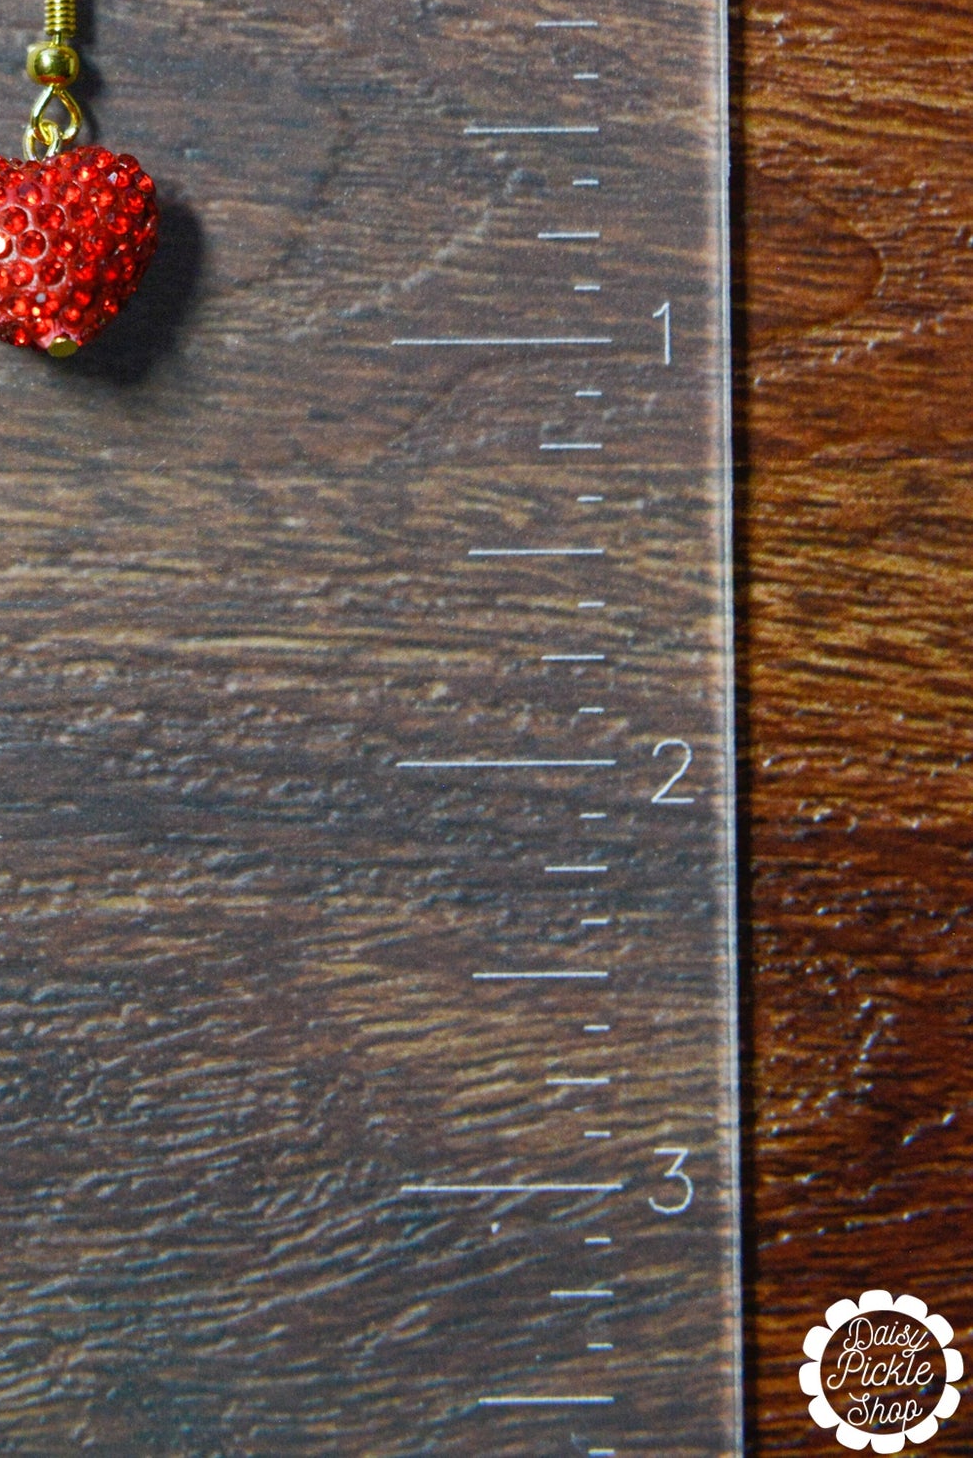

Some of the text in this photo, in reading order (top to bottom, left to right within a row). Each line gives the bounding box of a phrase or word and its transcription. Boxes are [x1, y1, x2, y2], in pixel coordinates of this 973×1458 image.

[652, 301, 671, 366] 1
[651, 738, 695, 804] 2
[648, 1147, 695, 1215] 3
